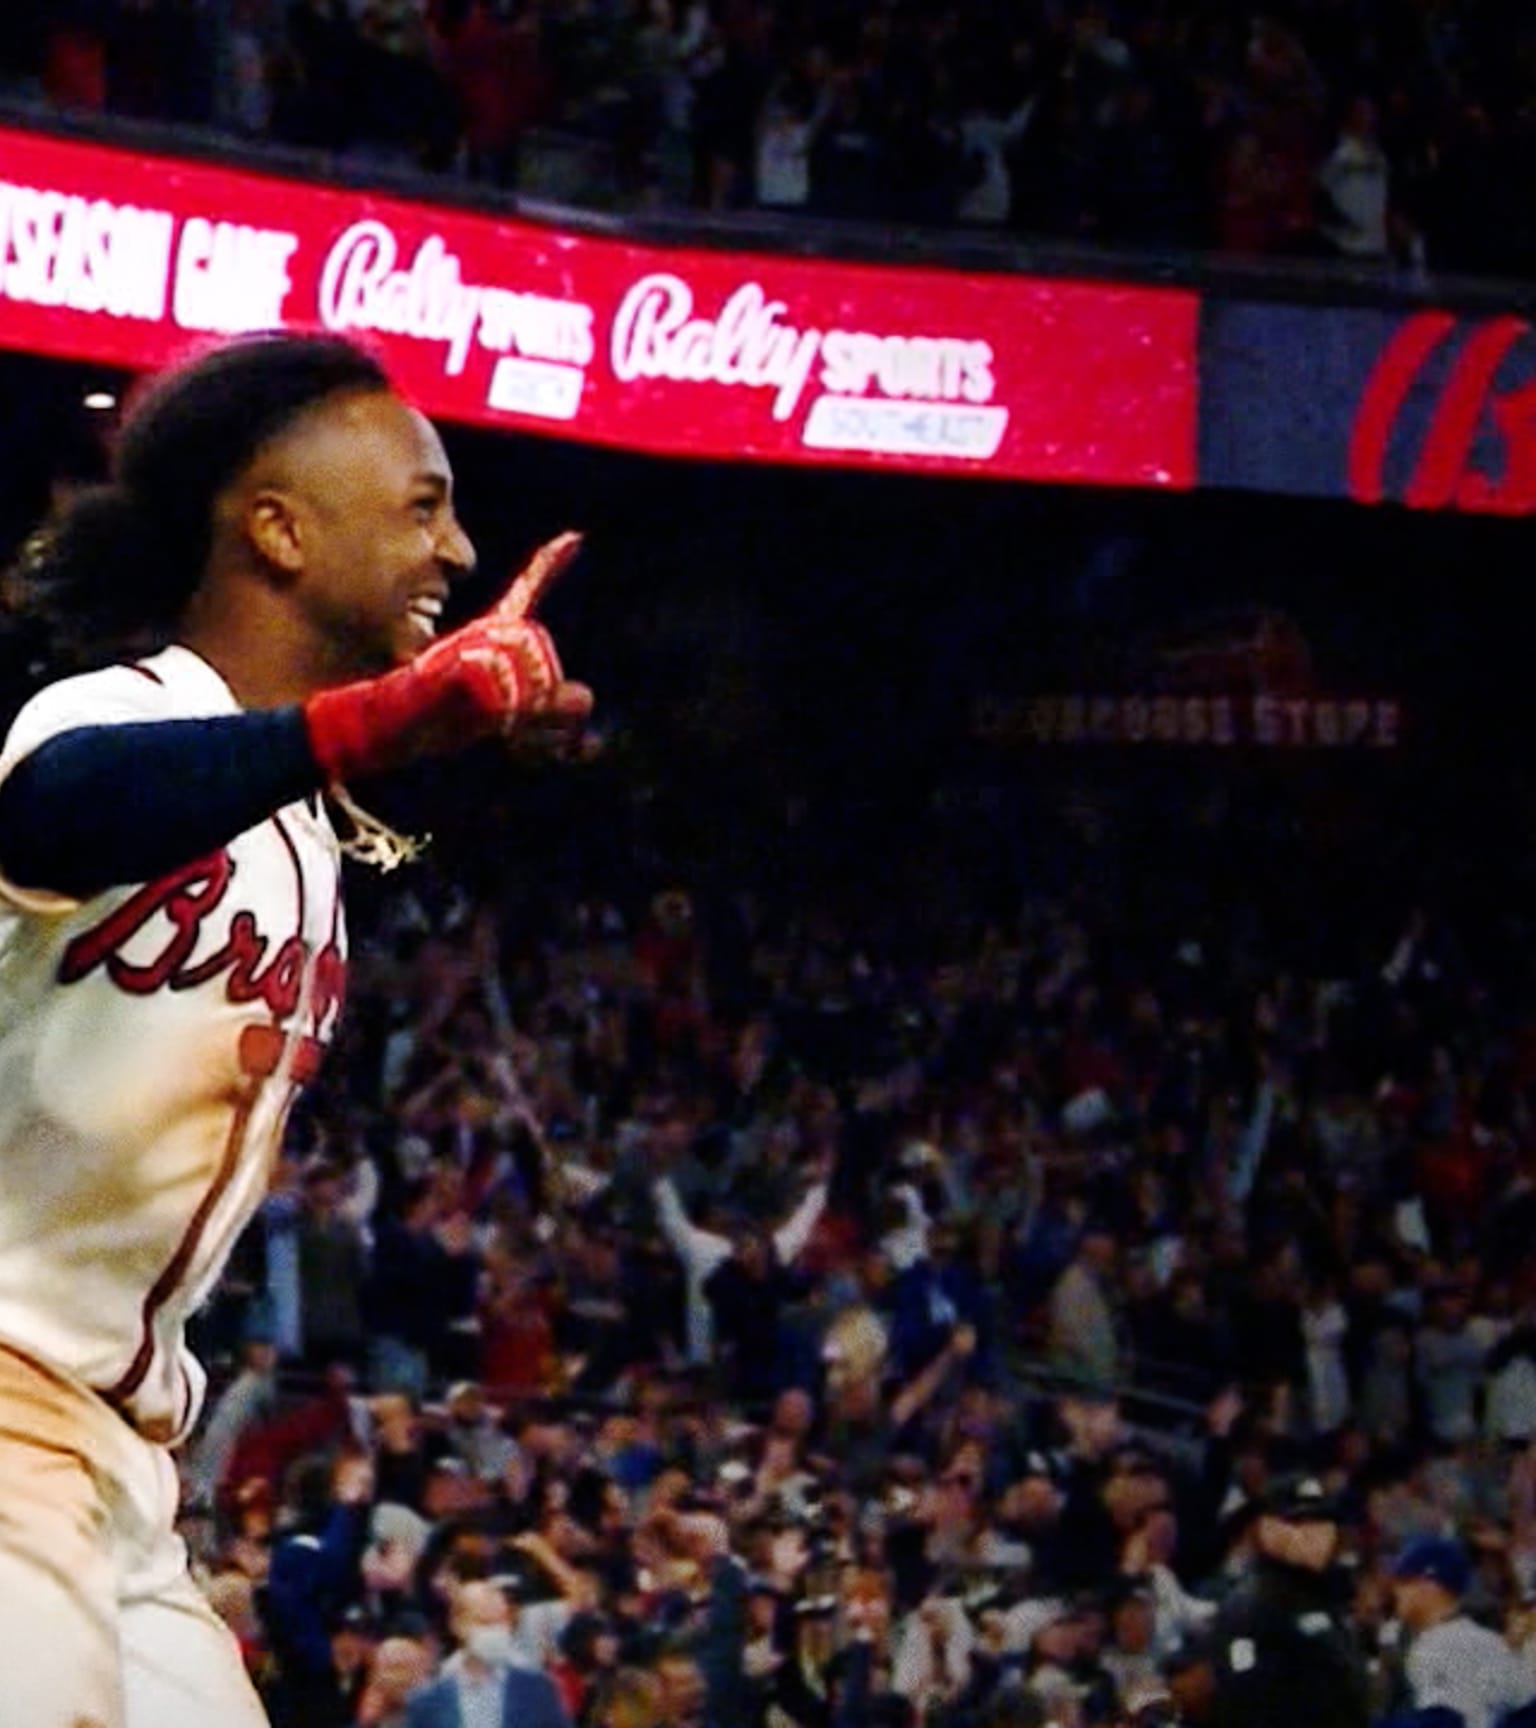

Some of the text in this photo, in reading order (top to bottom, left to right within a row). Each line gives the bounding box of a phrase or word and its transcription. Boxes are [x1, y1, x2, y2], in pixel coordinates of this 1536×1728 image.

[173, 217, 297, 333] GAME
[319, 220, 480, 376] Bally
[610, 274, 995, 421] Bally SPORTS
